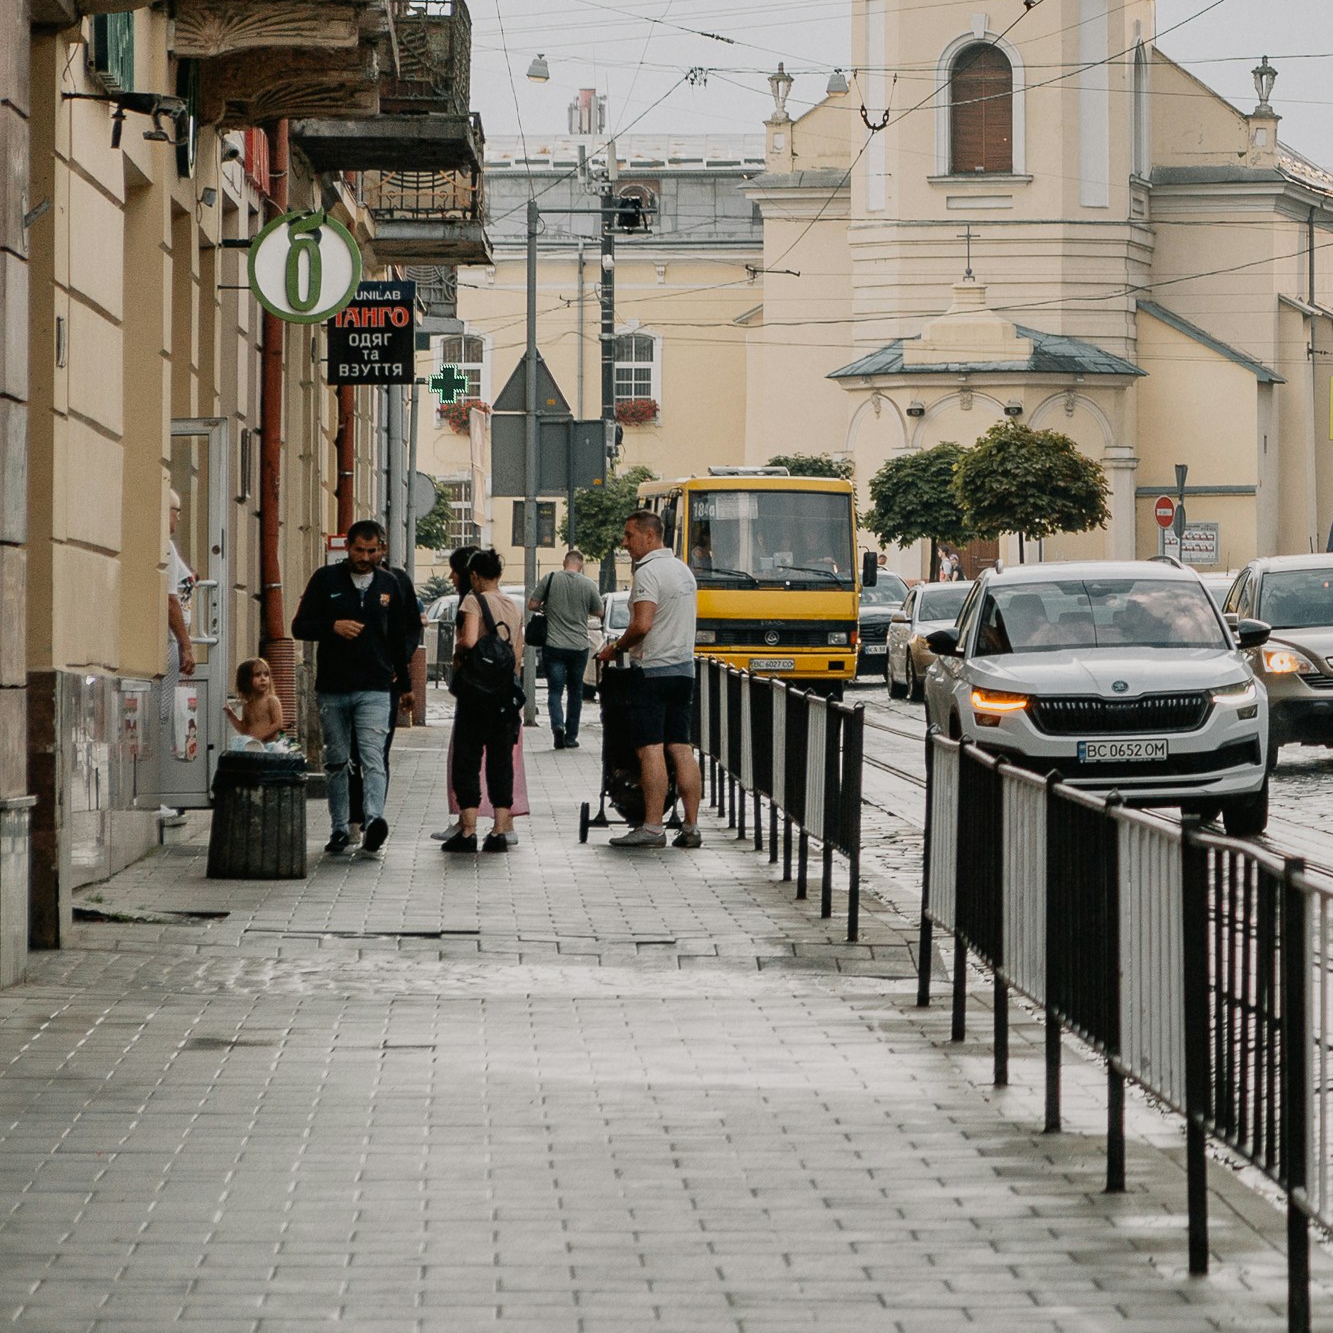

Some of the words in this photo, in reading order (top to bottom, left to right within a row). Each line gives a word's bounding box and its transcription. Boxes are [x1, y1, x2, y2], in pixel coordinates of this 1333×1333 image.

[348, 333, 392, 348] ОДЯГ
[362, 349, 380, 361] та
[339, 363, 403, 377] ВЗУТТЯ
[1087, 744, 1107, 757] BC
[1109, 743, 1142, 757] 0652
[1144, 743, 1165, 756] OM
